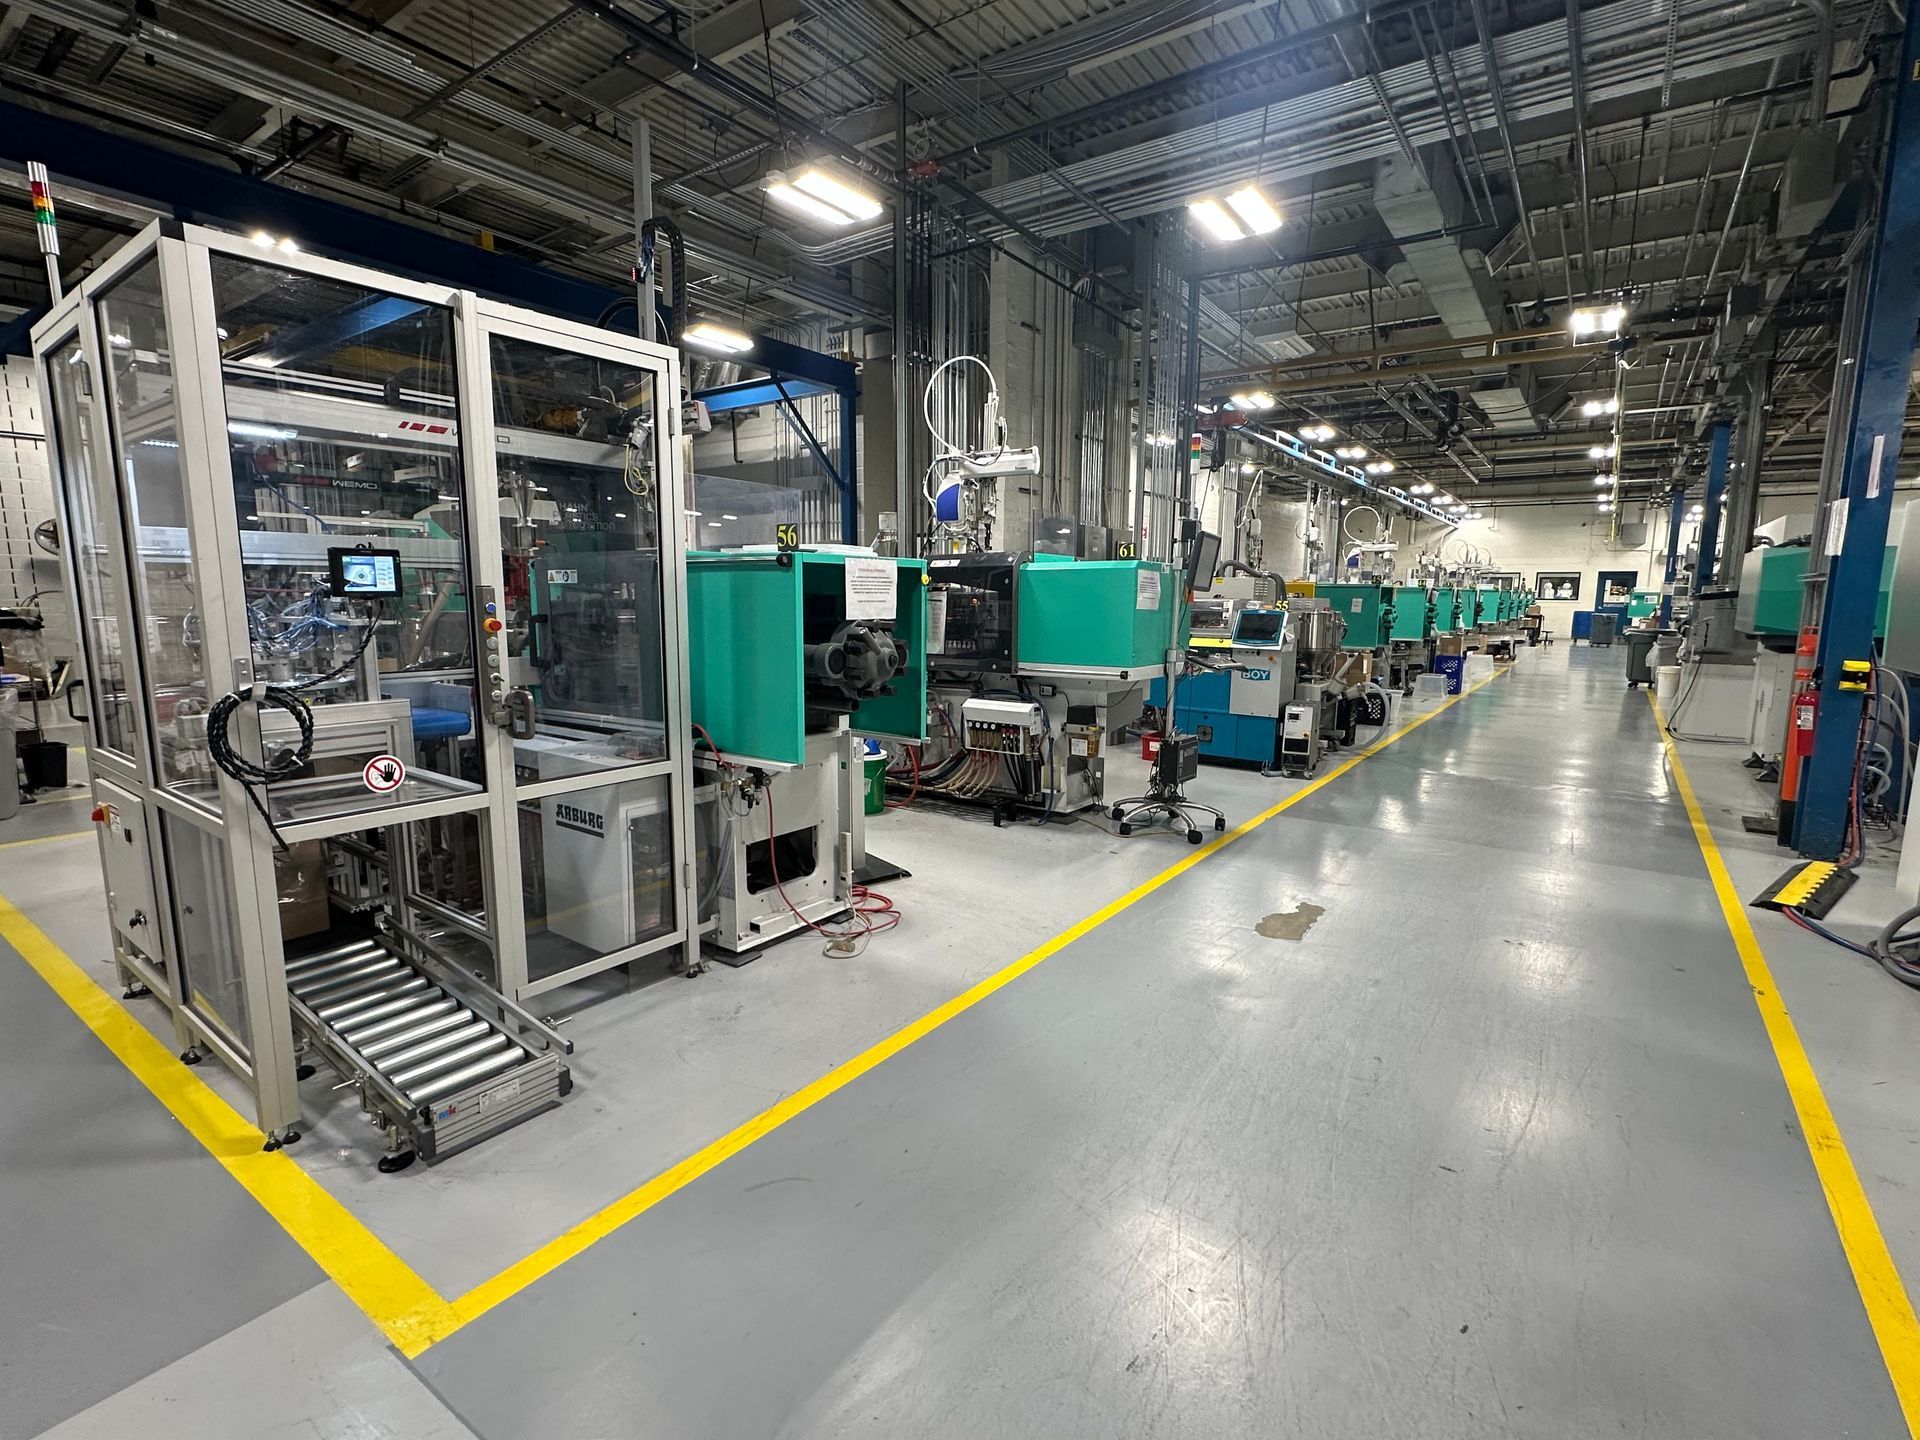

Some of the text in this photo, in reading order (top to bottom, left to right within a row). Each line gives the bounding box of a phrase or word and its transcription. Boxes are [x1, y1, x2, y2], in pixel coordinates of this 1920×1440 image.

[332, 479, 378, 490] WEMO
[777, 524, 797, 547] 56
[1119, 543, 1135, 558] 61
[1275, 600, 1289, 611] 55
[1242, 670, 1269, 680] BOY
[556, 803, 604, 830] ARBURG
